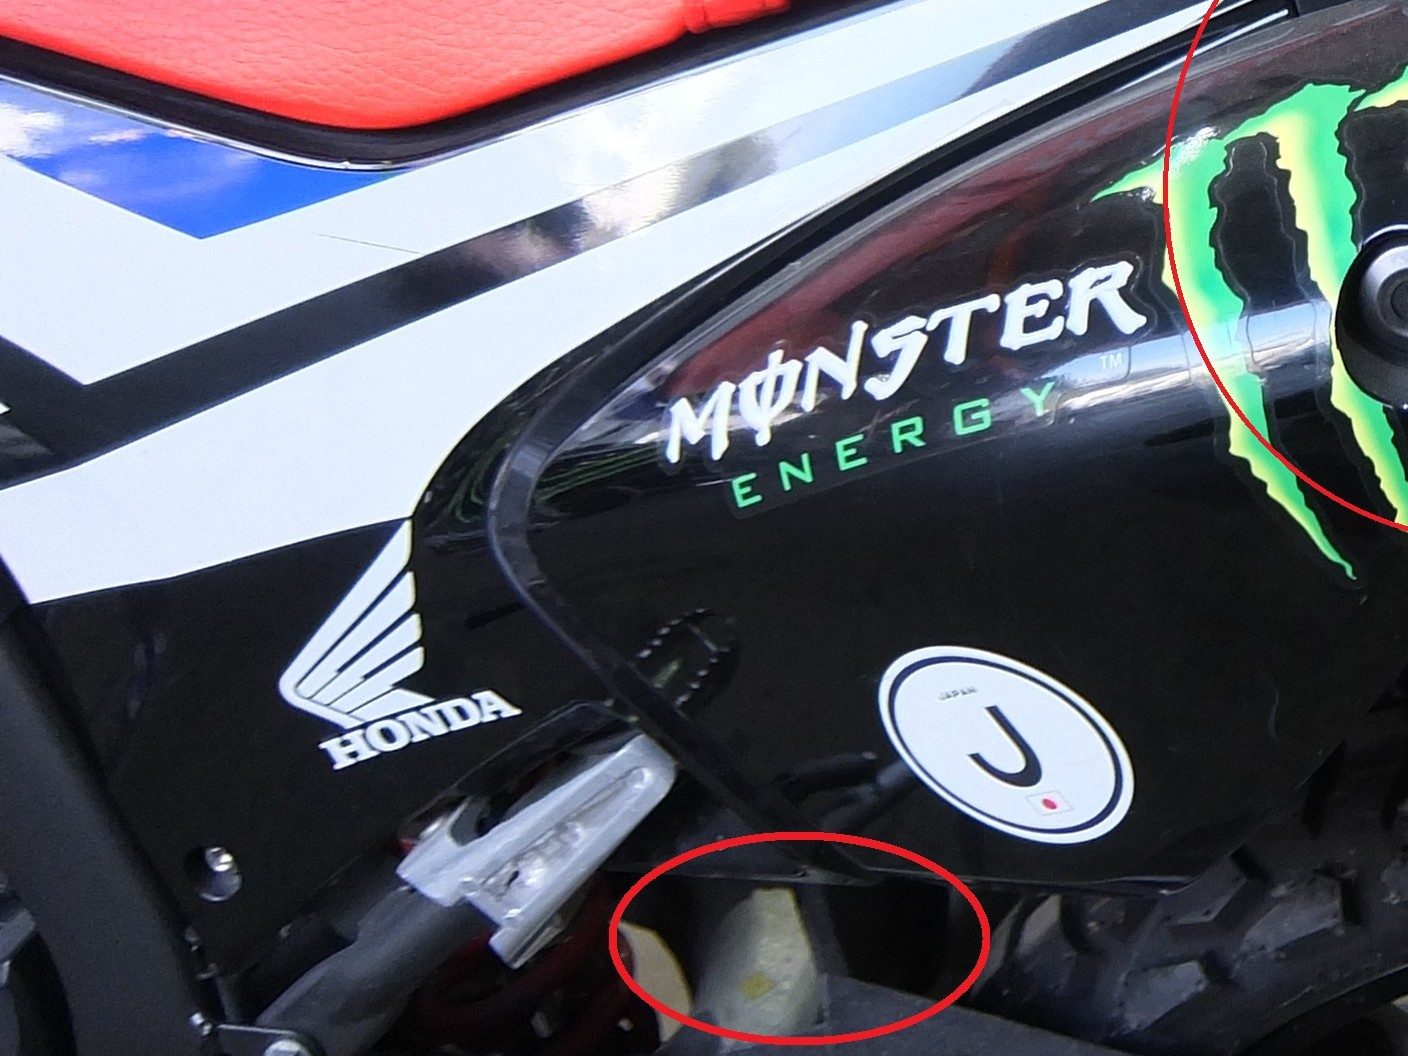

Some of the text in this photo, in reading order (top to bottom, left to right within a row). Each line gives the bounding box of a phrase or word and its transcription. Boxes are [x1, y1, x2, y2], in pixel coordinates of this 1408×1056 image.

[731, 381, 1056, 508] ENERGY
[318, 690, 522, 770] HONDA
[968, 705, 1043, 788] J
